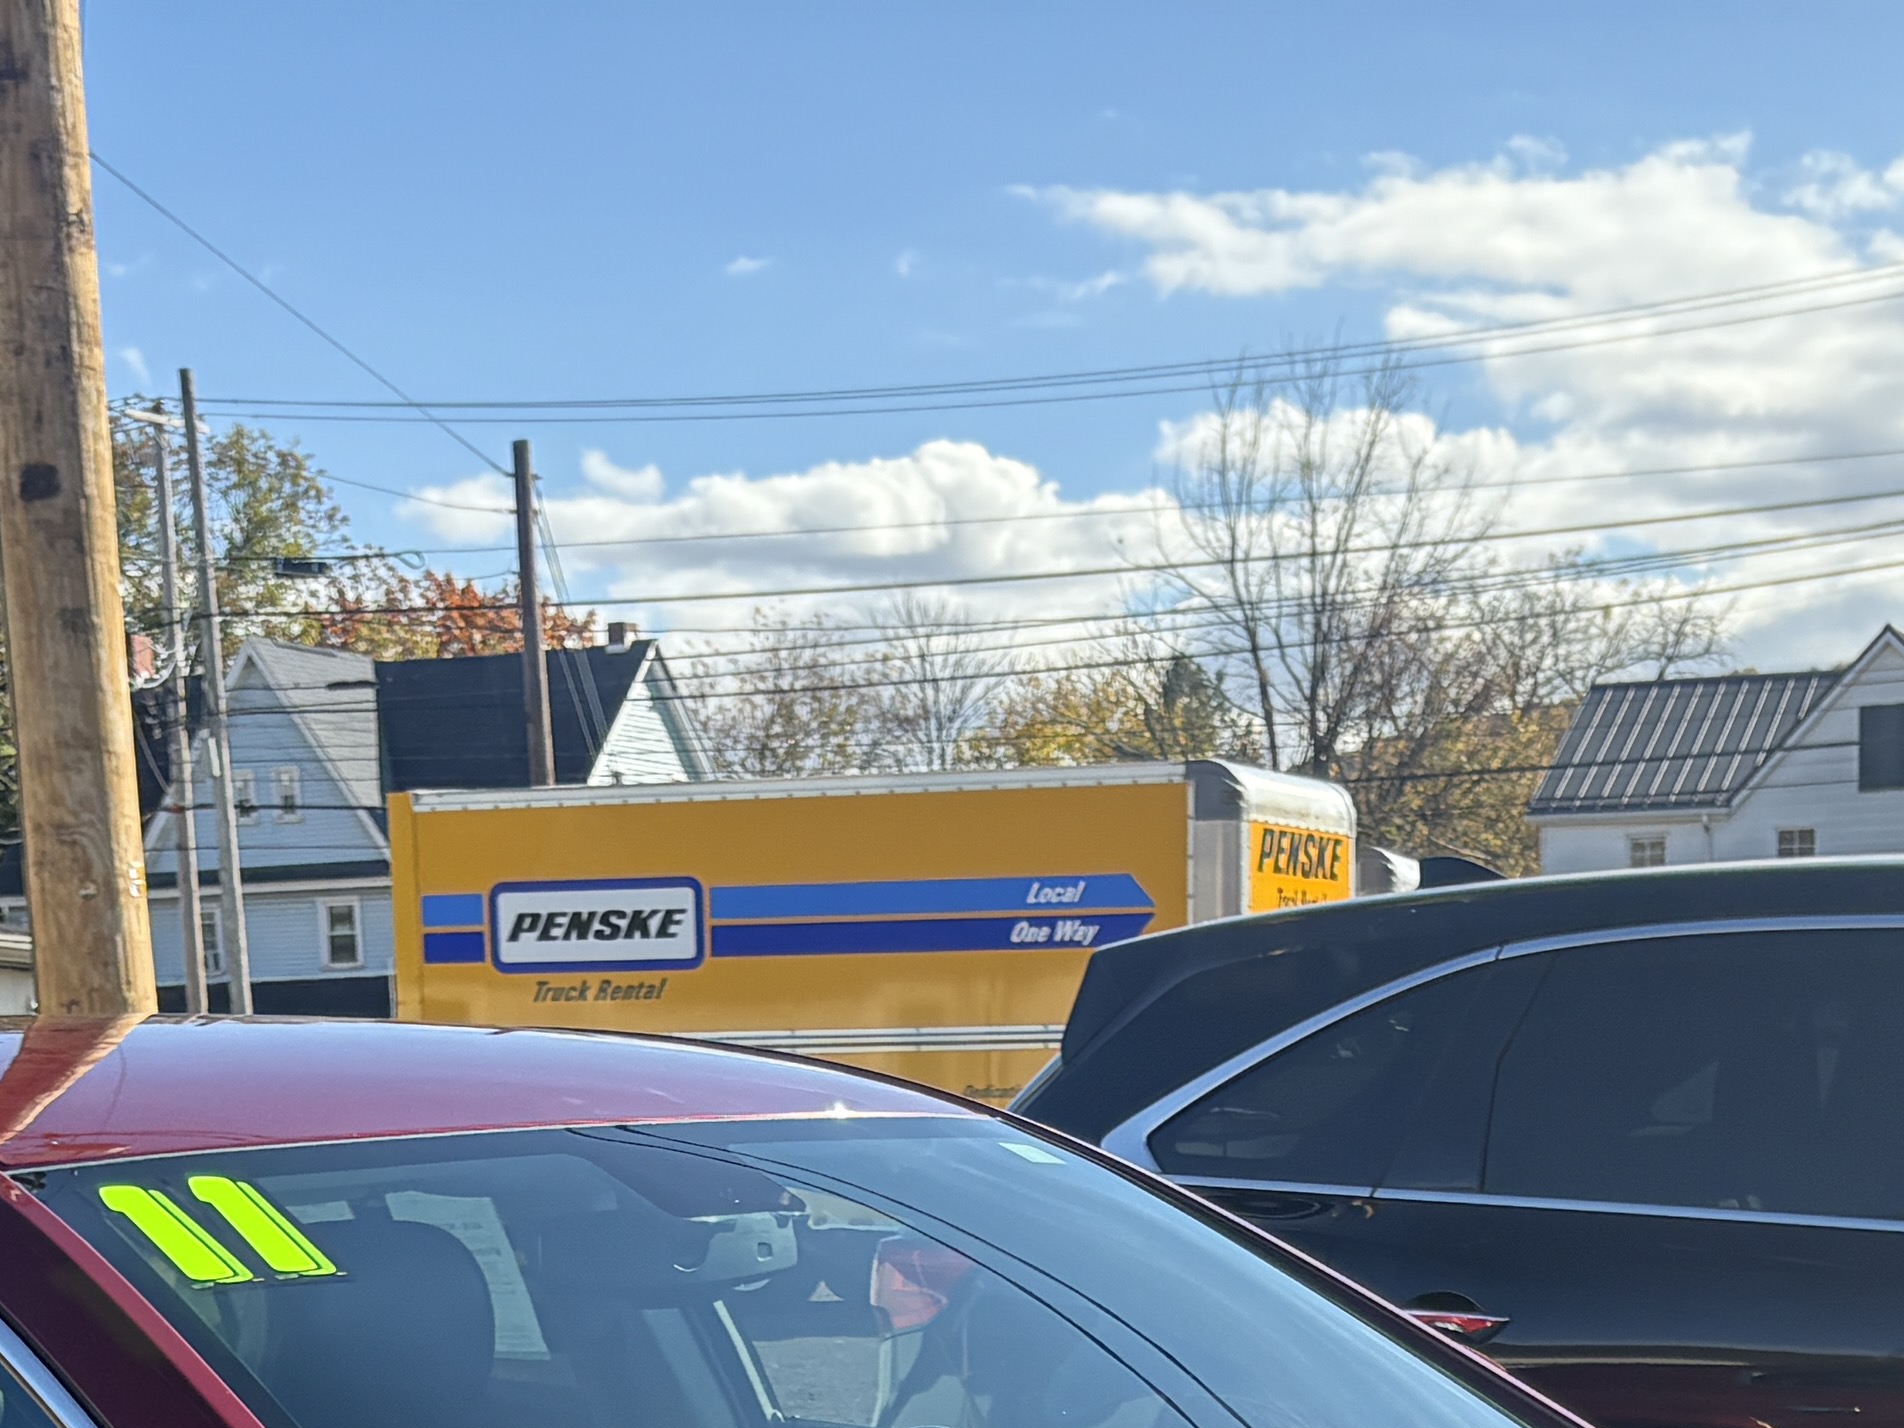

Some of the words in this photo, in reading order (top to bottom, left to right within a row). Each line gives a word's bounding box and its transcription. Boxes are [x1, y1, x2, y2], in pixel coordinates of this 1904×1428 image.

[1258, 828, 1343, 881] PENSKE
[1026, 880, 1086, 904] Local
[506, 908, 688, 942] PENSKE
[1009, 920, 1052, 943] One
[1053, 919, 1101, 946] Way
[533, 980, 591, 1003] Truck
[593, 977, 668, 1001] Rental
[99, 1175, 337, 1284] 11
